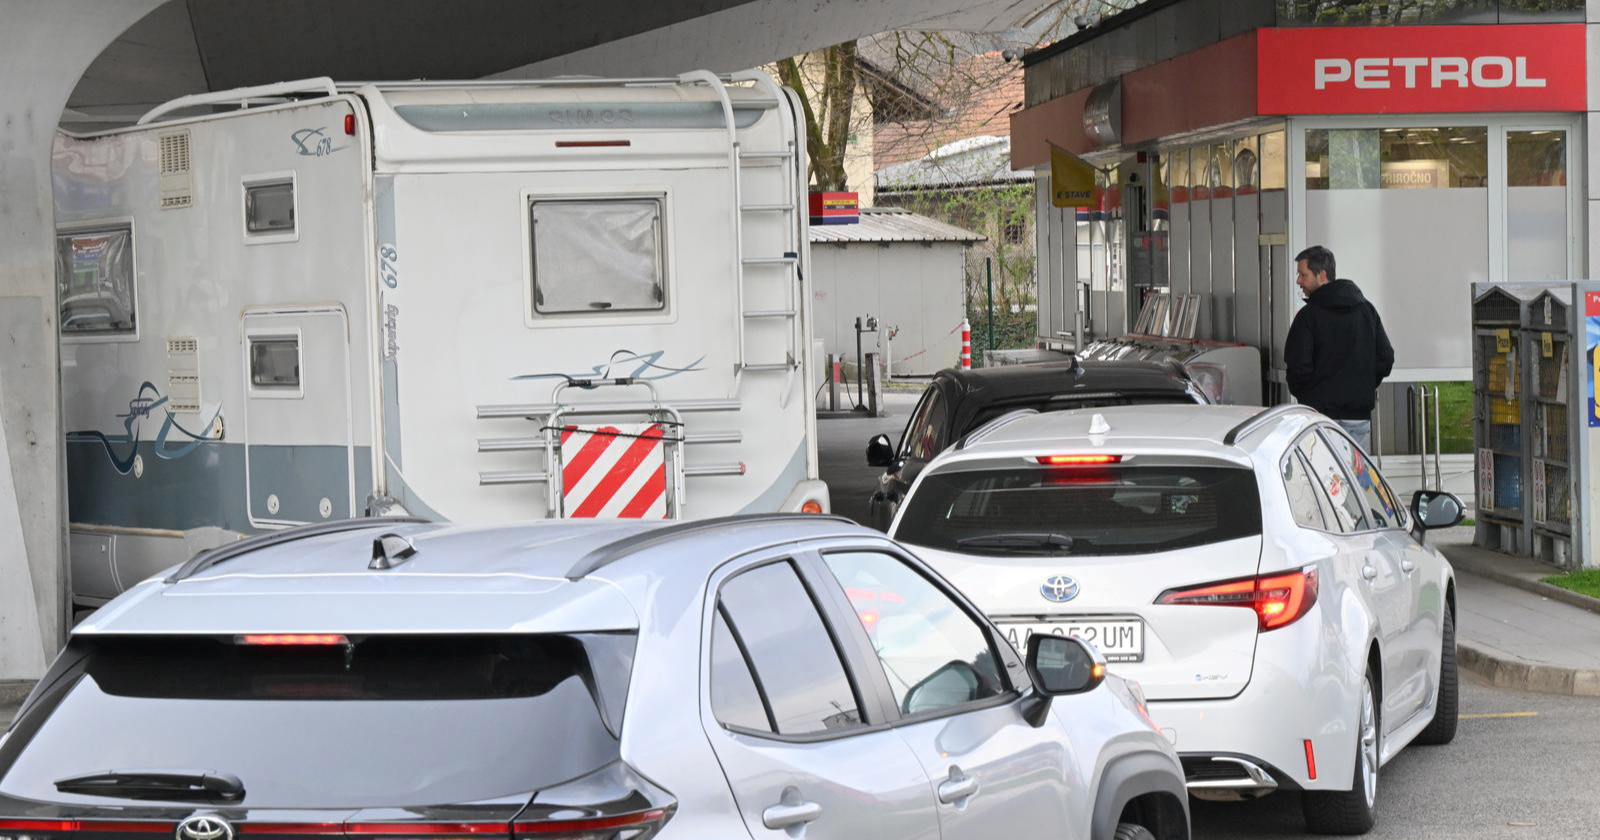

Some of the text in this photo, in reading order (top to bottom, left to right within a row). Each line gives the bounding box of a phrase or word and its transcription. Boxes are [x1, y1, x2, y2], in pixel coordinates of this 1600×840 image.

[1313, 56, 1547, 90] PETROL
[316, 137, 332, 157] 678
[380, 246, 397, 289] 678
